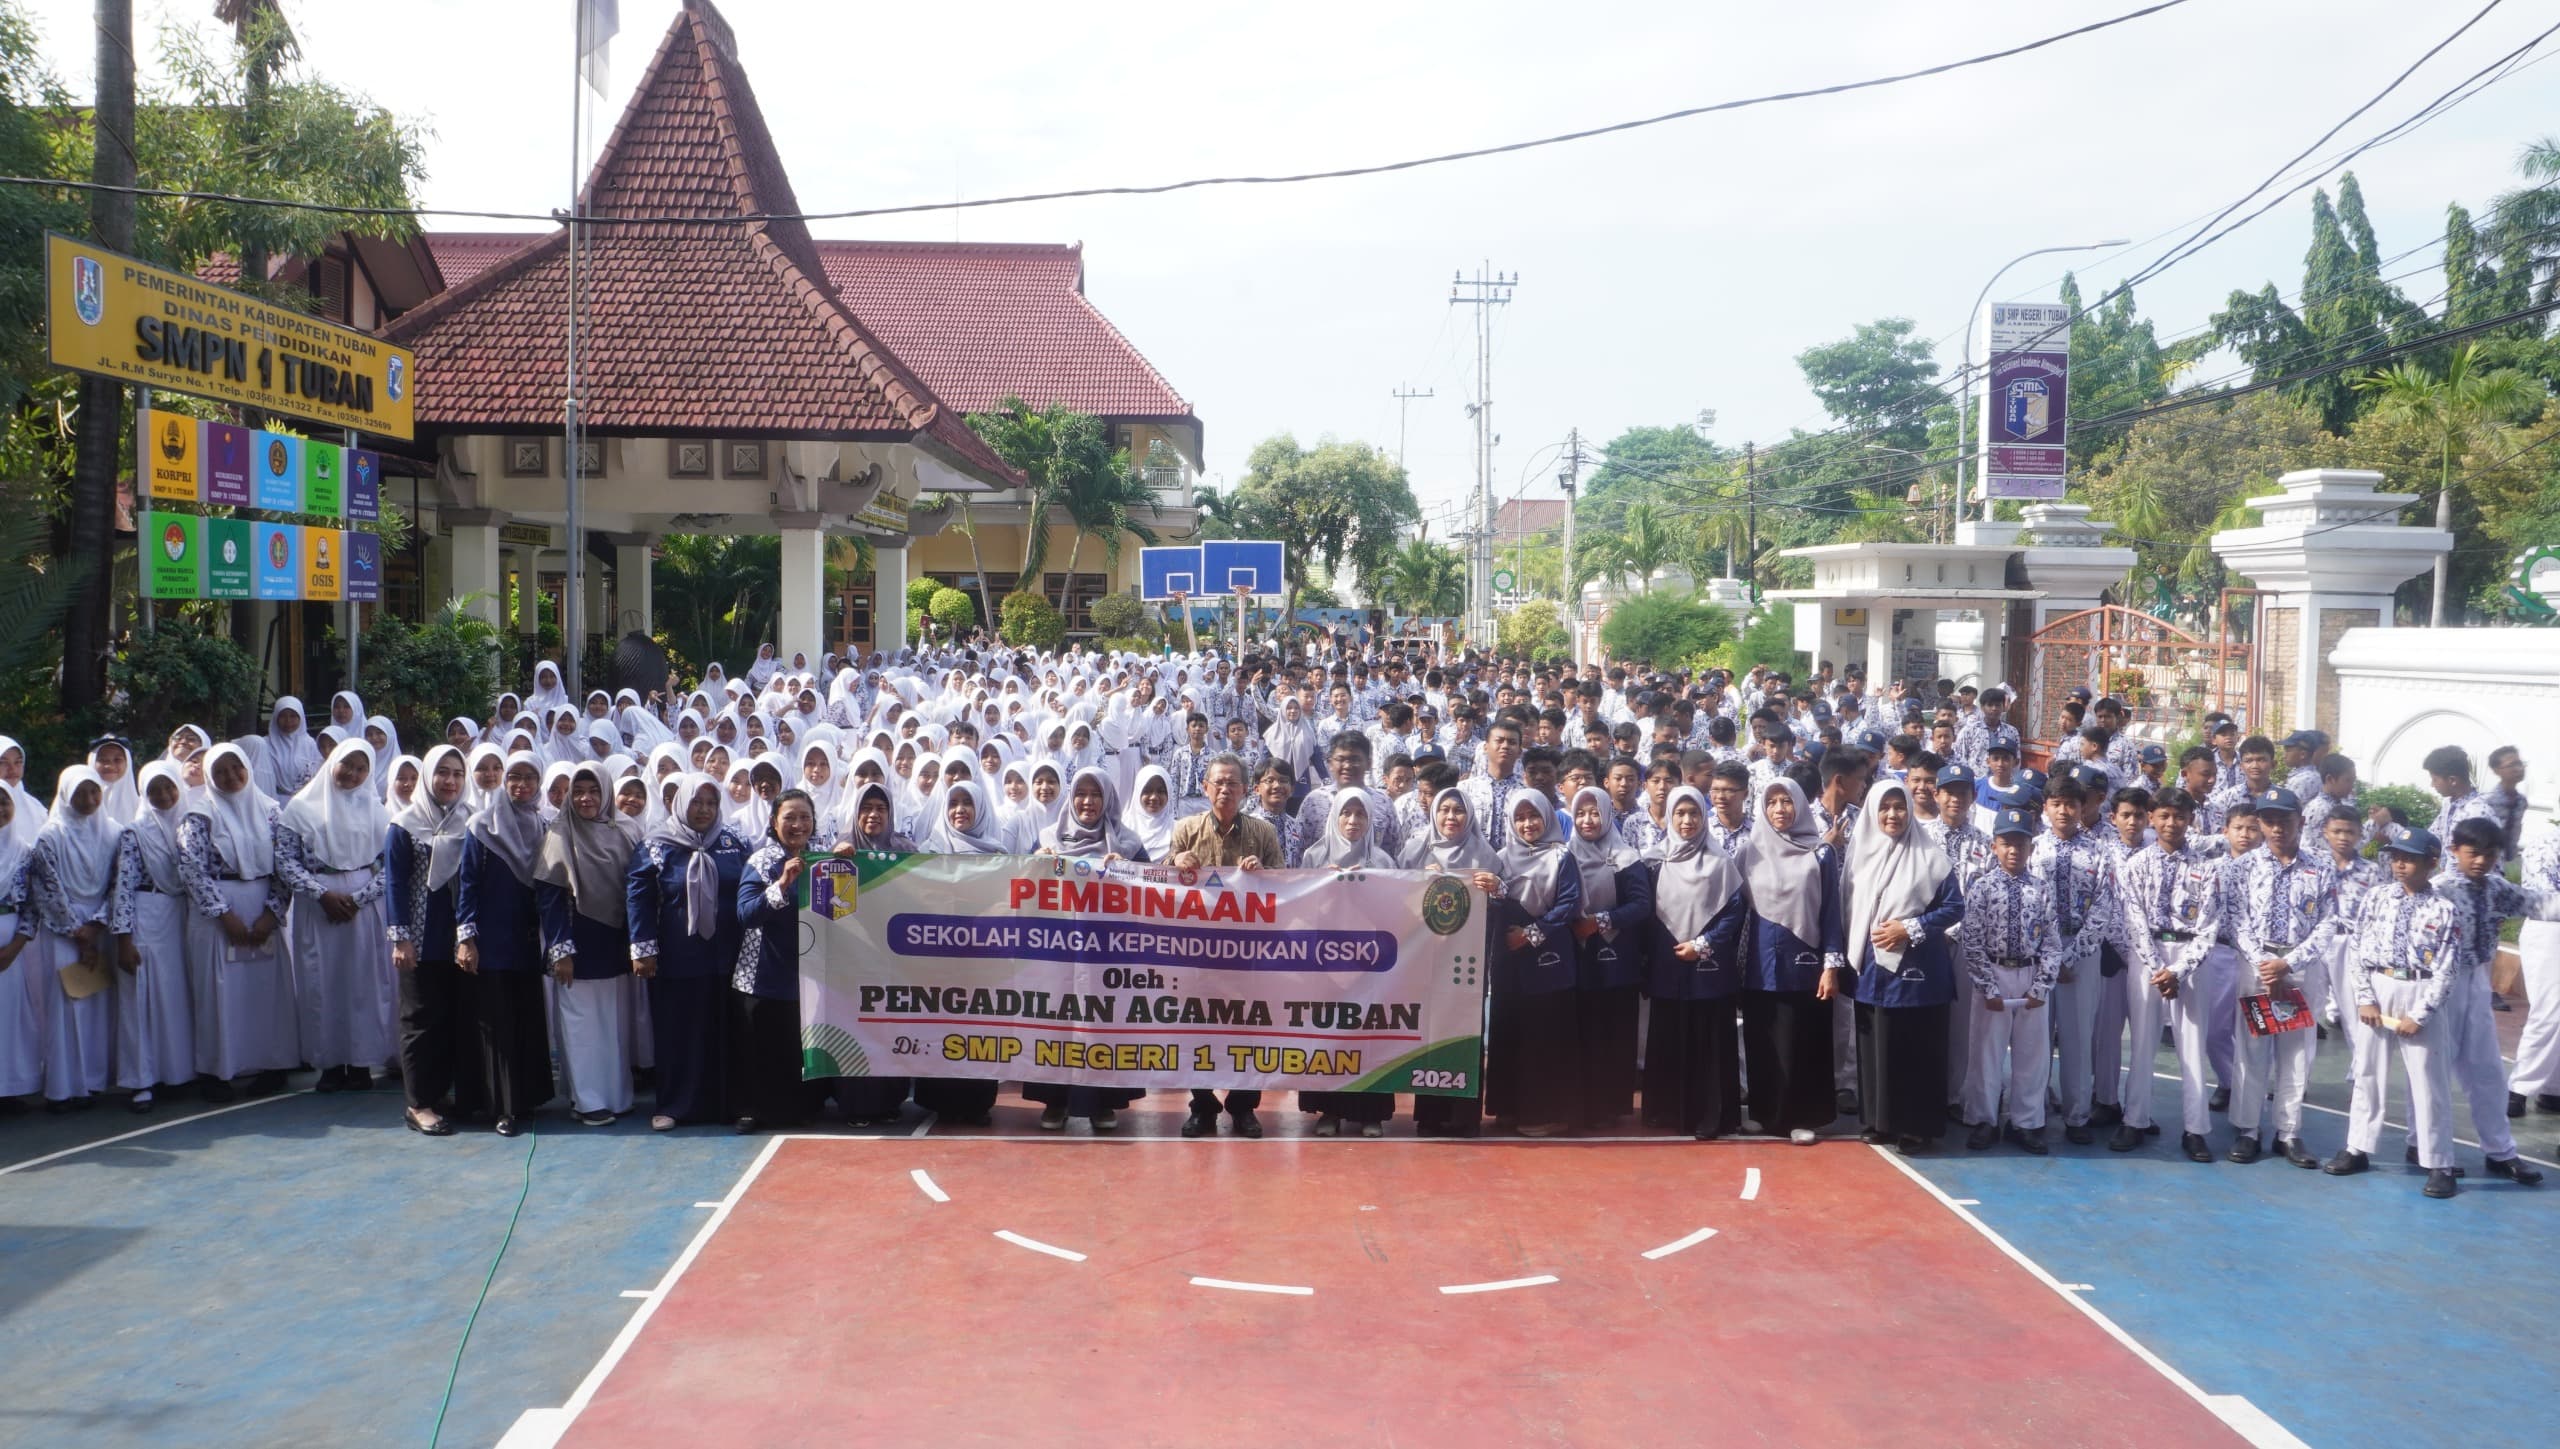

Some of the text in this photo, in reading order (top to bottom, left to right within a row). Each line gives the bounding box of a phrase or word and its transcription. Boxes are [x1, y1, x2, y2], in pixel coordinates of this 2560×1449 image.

[123, 266, 377, 358] PEMERINTAH KABUPATEN TUBAN
[163, 300, 352, 367] DINAS PENDIDIKAN
[136, 315, 247, 383] SMPN
[257, 347, 273, 389] 1
[280, 353, 374, 413] TUBAN
[97, 356, 117, 369] JL.
[147, 366, 183, 384] Suryo
[185, 375, 205, 389] No.
[217, 382, 244, 397] Telp.
[316, 405, 335, 418] Fax.
[156, 468, 192, 483] KORPRI
[312, 573, 335, 588] OSIS
[1010, 878, 1277, 924] PEMBINAAN
[906, 925, 1380, 966] SEKOLAH SIAGA KEPENDUDUKAN (SSK)
[1102, 967, 1164, 990] Oleh
[859, 985, 1421, 1031] PENGADILAN AGAMA TUBAN
[891, 1036, 920, 1056] Di
[942, 1033, 1023, 1063] SMP
[1035, 1039, 1179, 1071] NEGERI
[1193, 1045, 1216, 1072] 1
[1227, 1044, 1361, 1076] TUBAN
[1411, 1068, 1467, 1090] 2024
